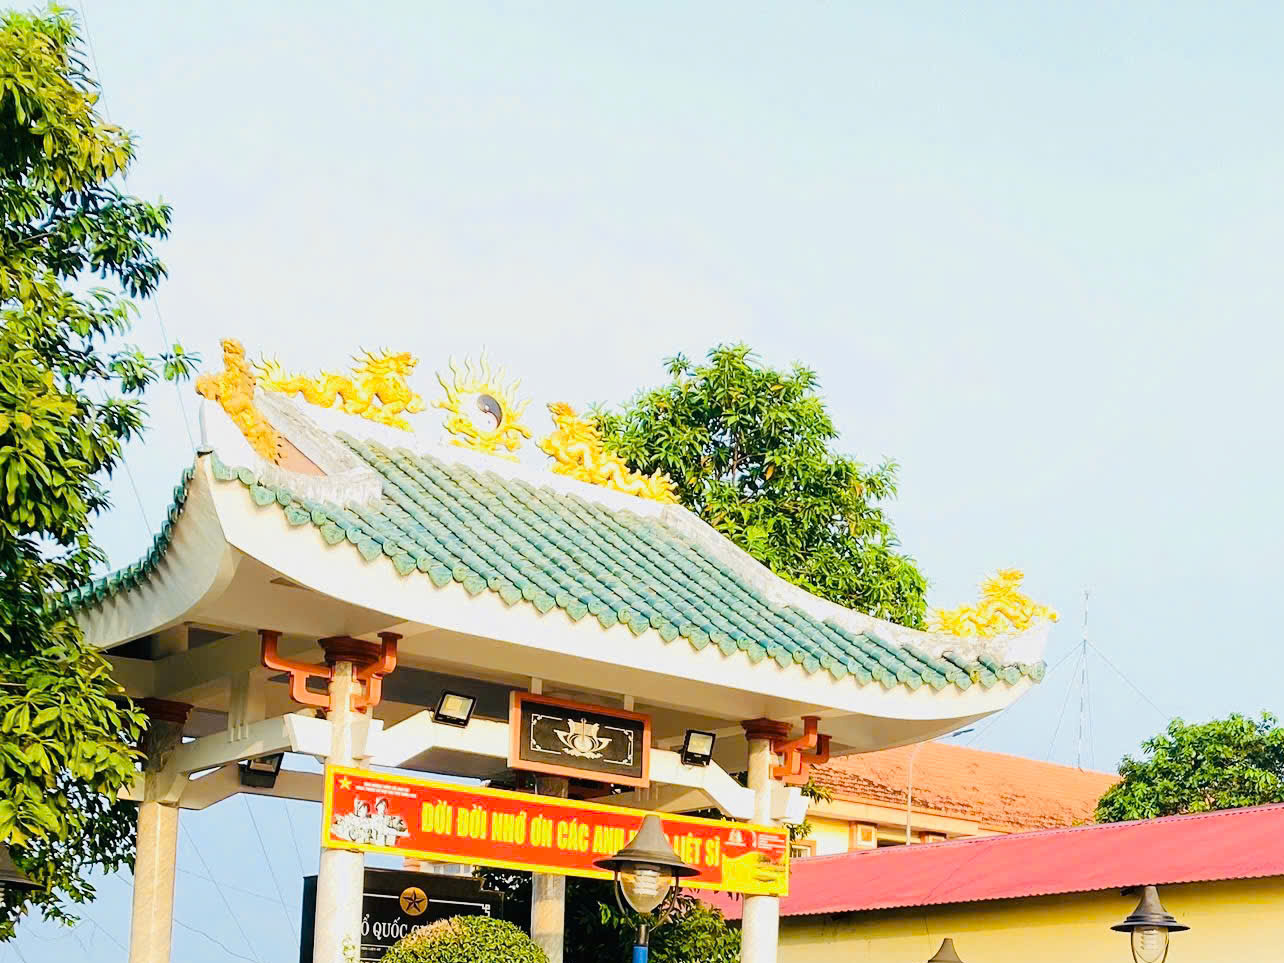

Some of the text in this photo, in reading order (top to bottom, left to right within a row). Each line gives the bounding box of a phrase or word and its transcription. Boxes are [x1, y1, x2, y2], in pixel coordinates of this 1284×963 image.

[557, 817, 590, 853] CÁC
[592, 825, 625, 856] ANH
[361, 913, 371, 937] Ổ
[373, 916, 408, 940] QUỐC
